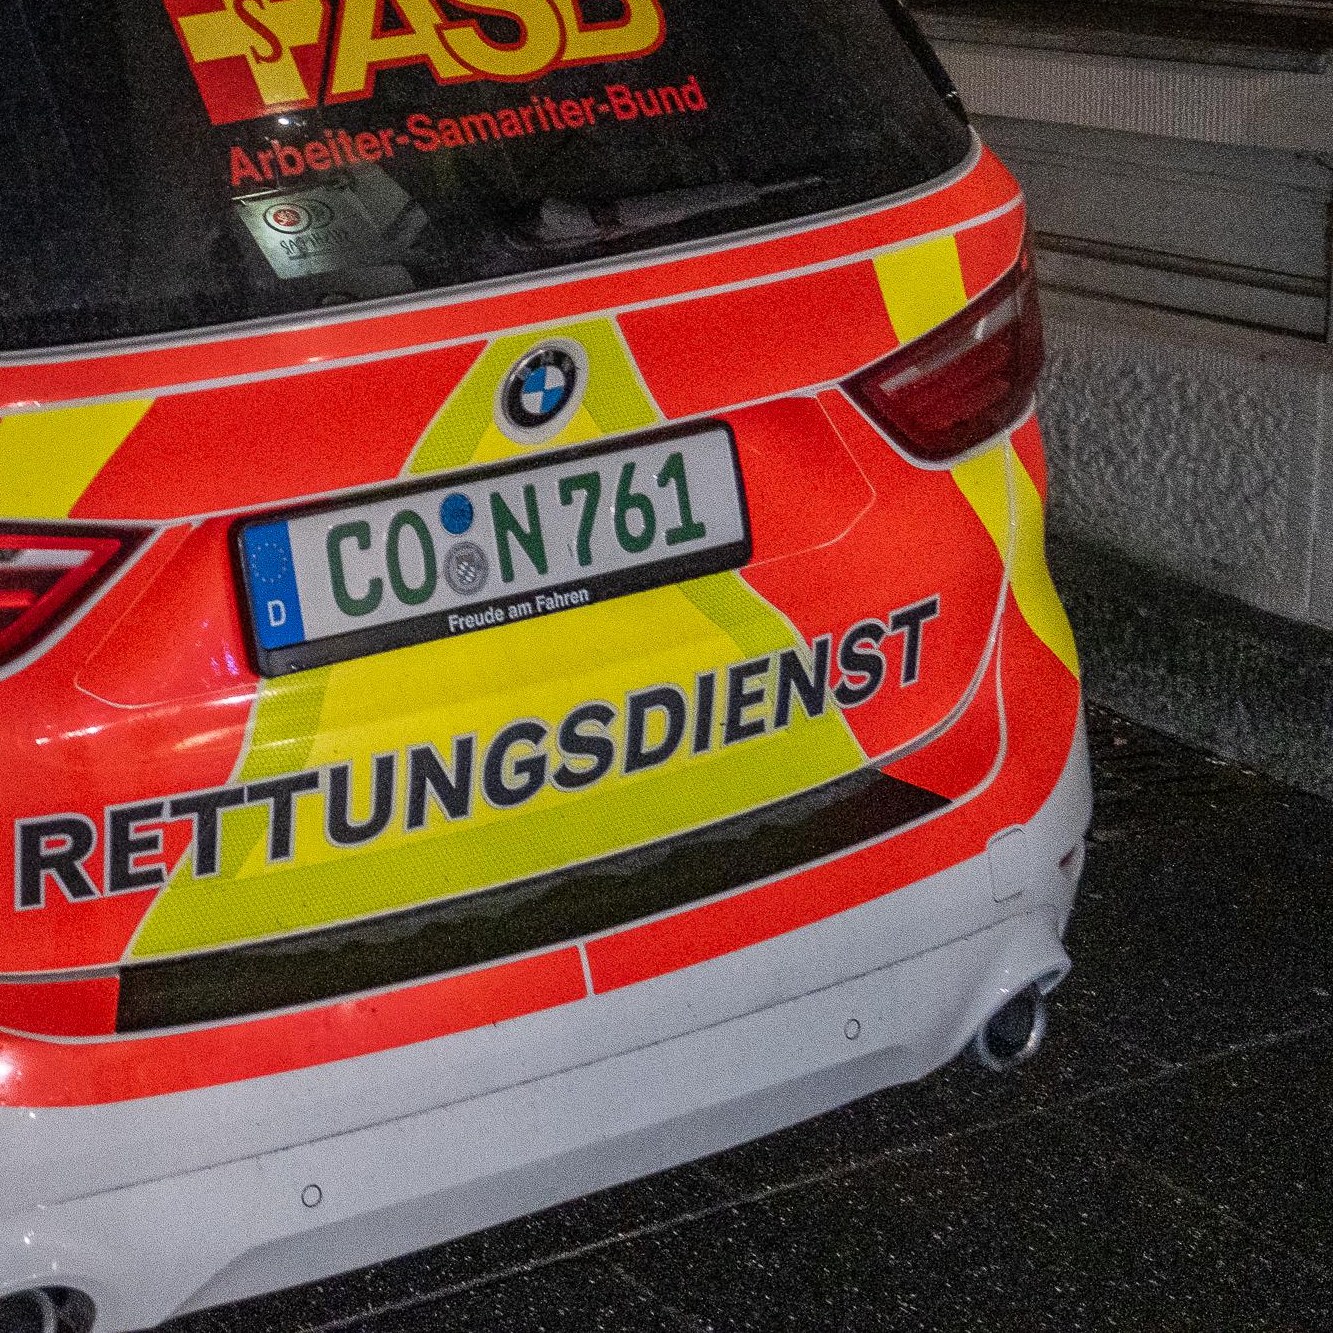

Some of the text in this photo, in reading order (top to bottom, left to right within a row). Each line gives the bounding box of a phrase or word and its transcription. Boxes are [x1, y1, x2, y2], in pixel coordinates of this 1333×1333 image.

[228, 76, 708, 188] Arbeiter-Samariter-Bund
[325, 451, 707, 617] CO N 761
[268, 599, 286, 628] D
[447, 587, 590, 632] Freude am Fahren
[15, 598, 938, 910] RETTUNGSDIENST
